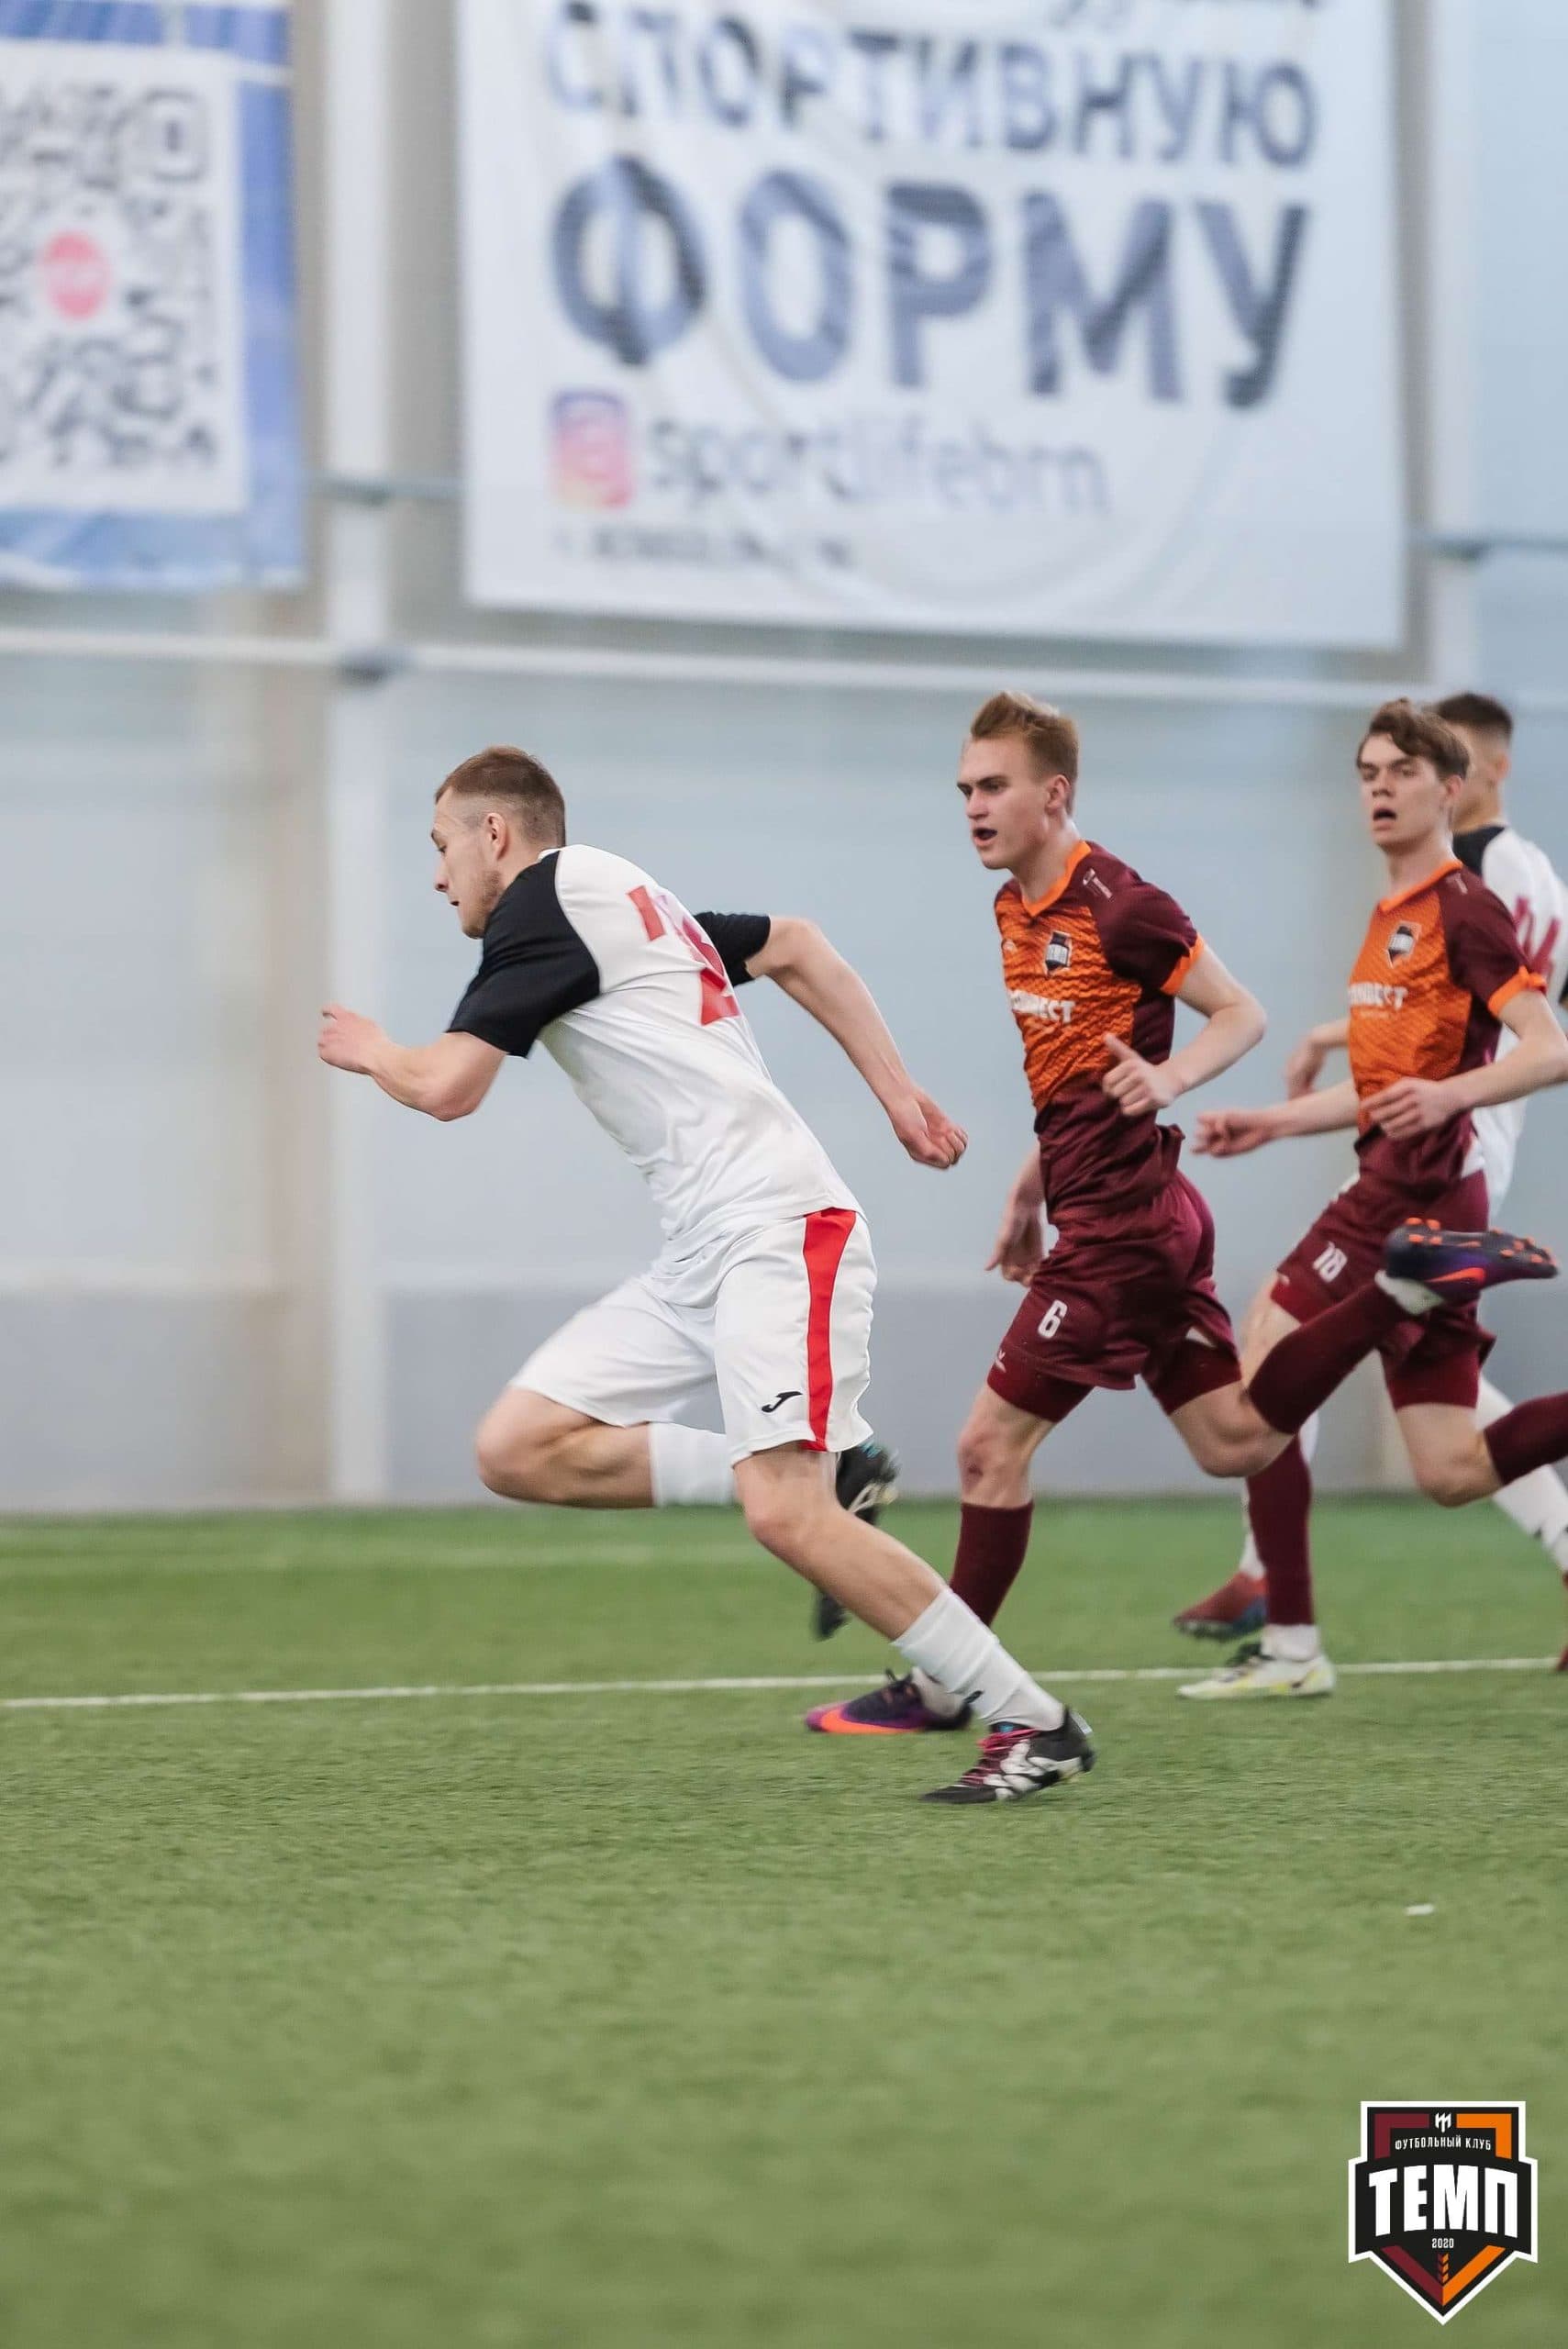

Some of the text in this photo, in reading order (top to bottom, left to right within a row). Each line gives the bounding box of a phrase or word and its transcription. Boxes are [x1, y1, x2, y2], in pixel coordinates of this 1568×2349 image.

[547, 0, 1318, 167] СПОРТИВНУЮ
[550, 153, 1312, 411] ФОРМУ
[1038, 1299, 1068, 1339] 6
